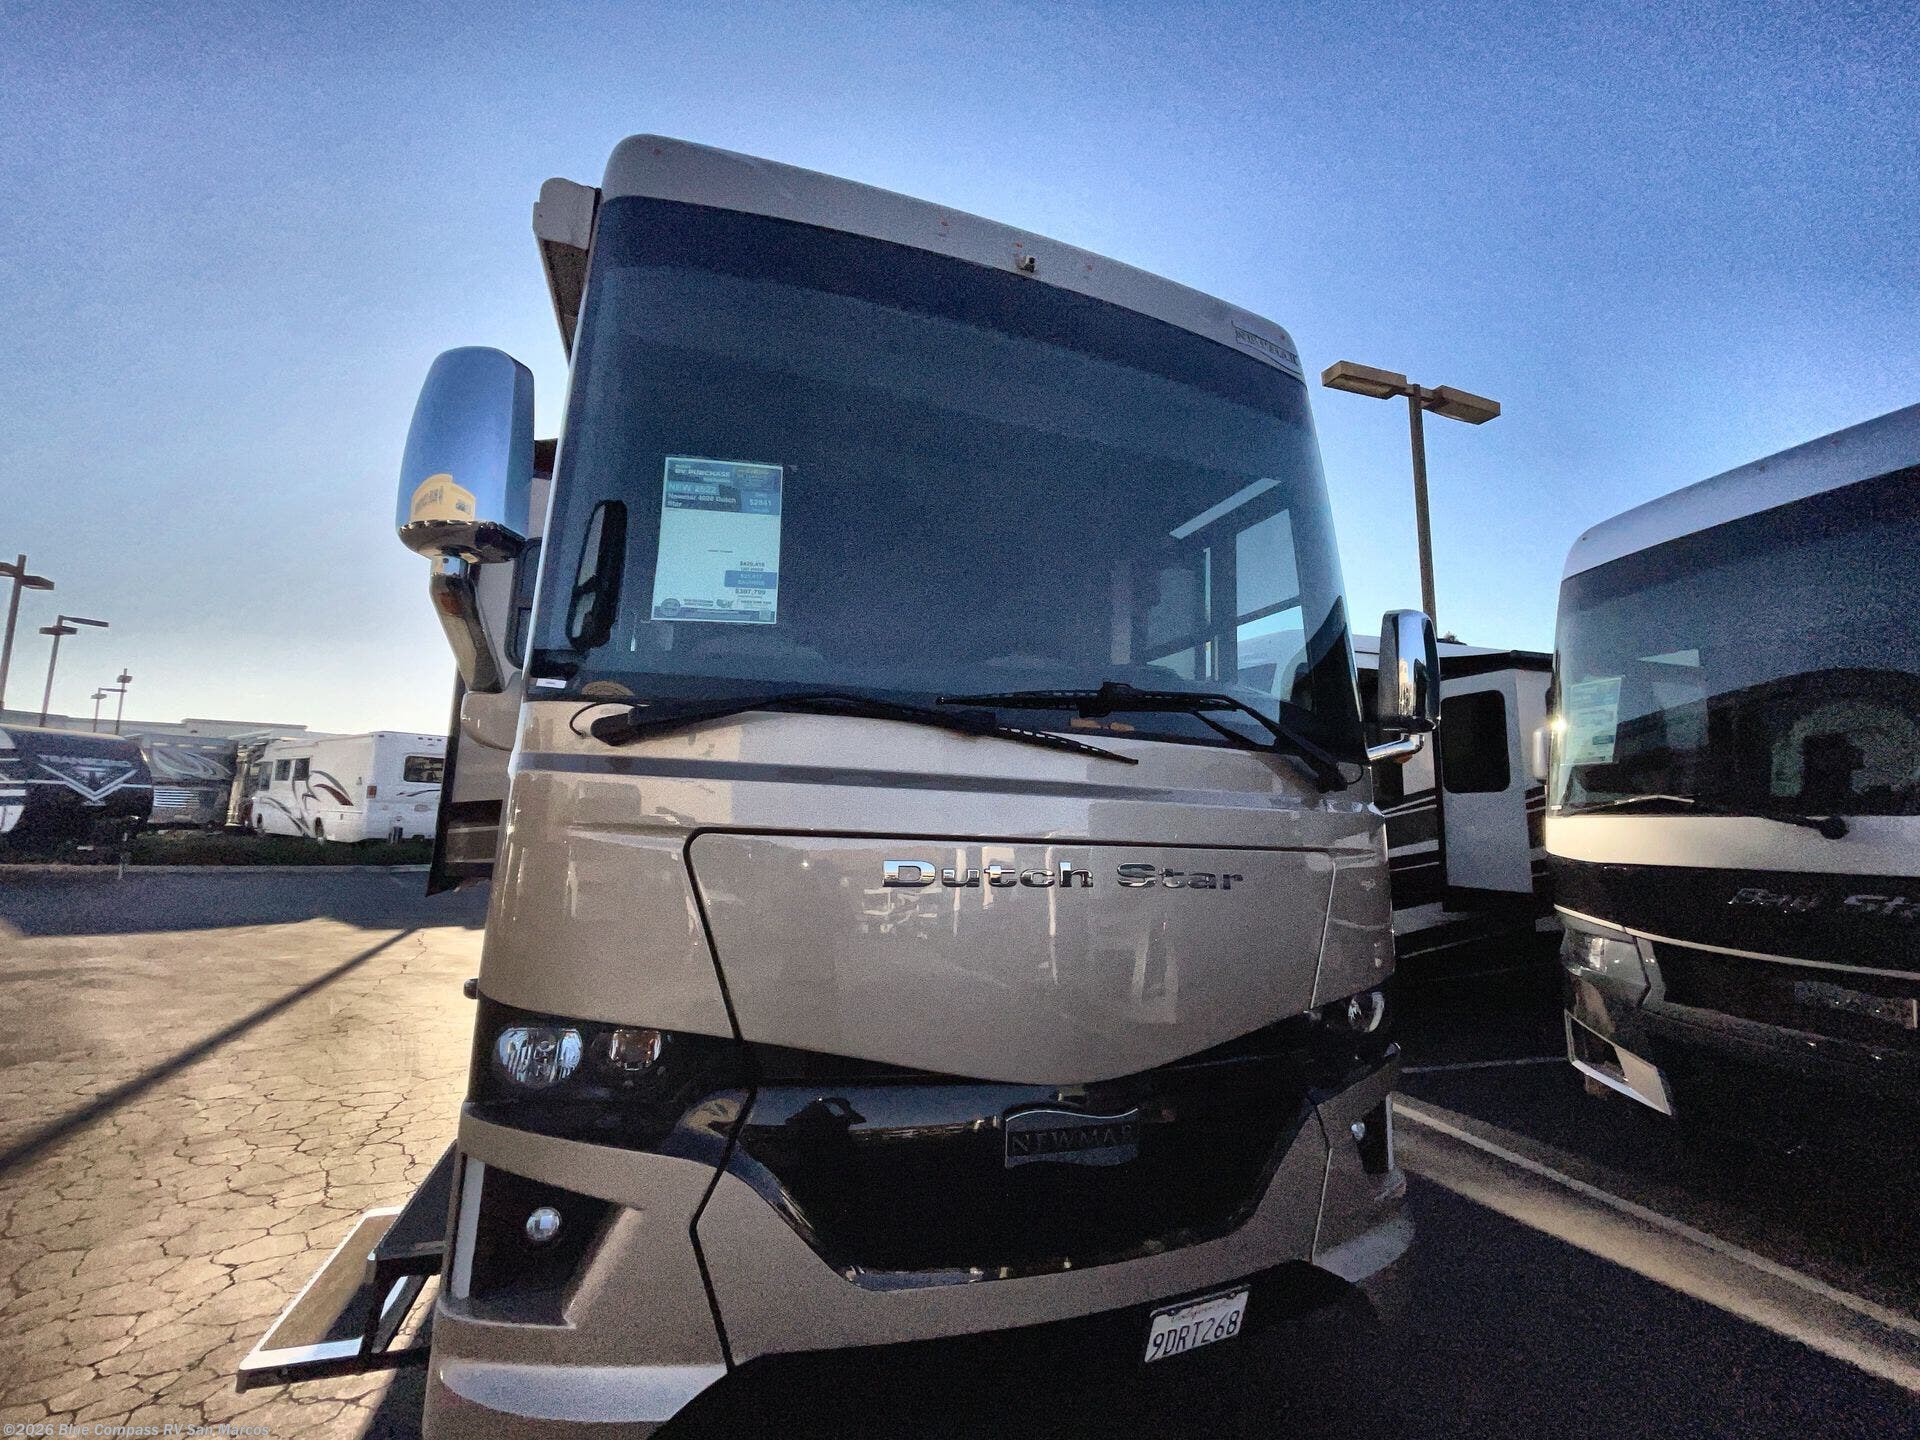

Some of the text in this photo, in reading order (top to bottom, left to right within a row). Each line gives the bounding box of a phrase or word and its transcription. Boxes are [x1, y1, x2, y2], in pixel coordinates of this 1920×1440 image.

[882, 859, 1243, 890] Dutch Star
[1148, 1310, 1240, 1361] 9DRT268
